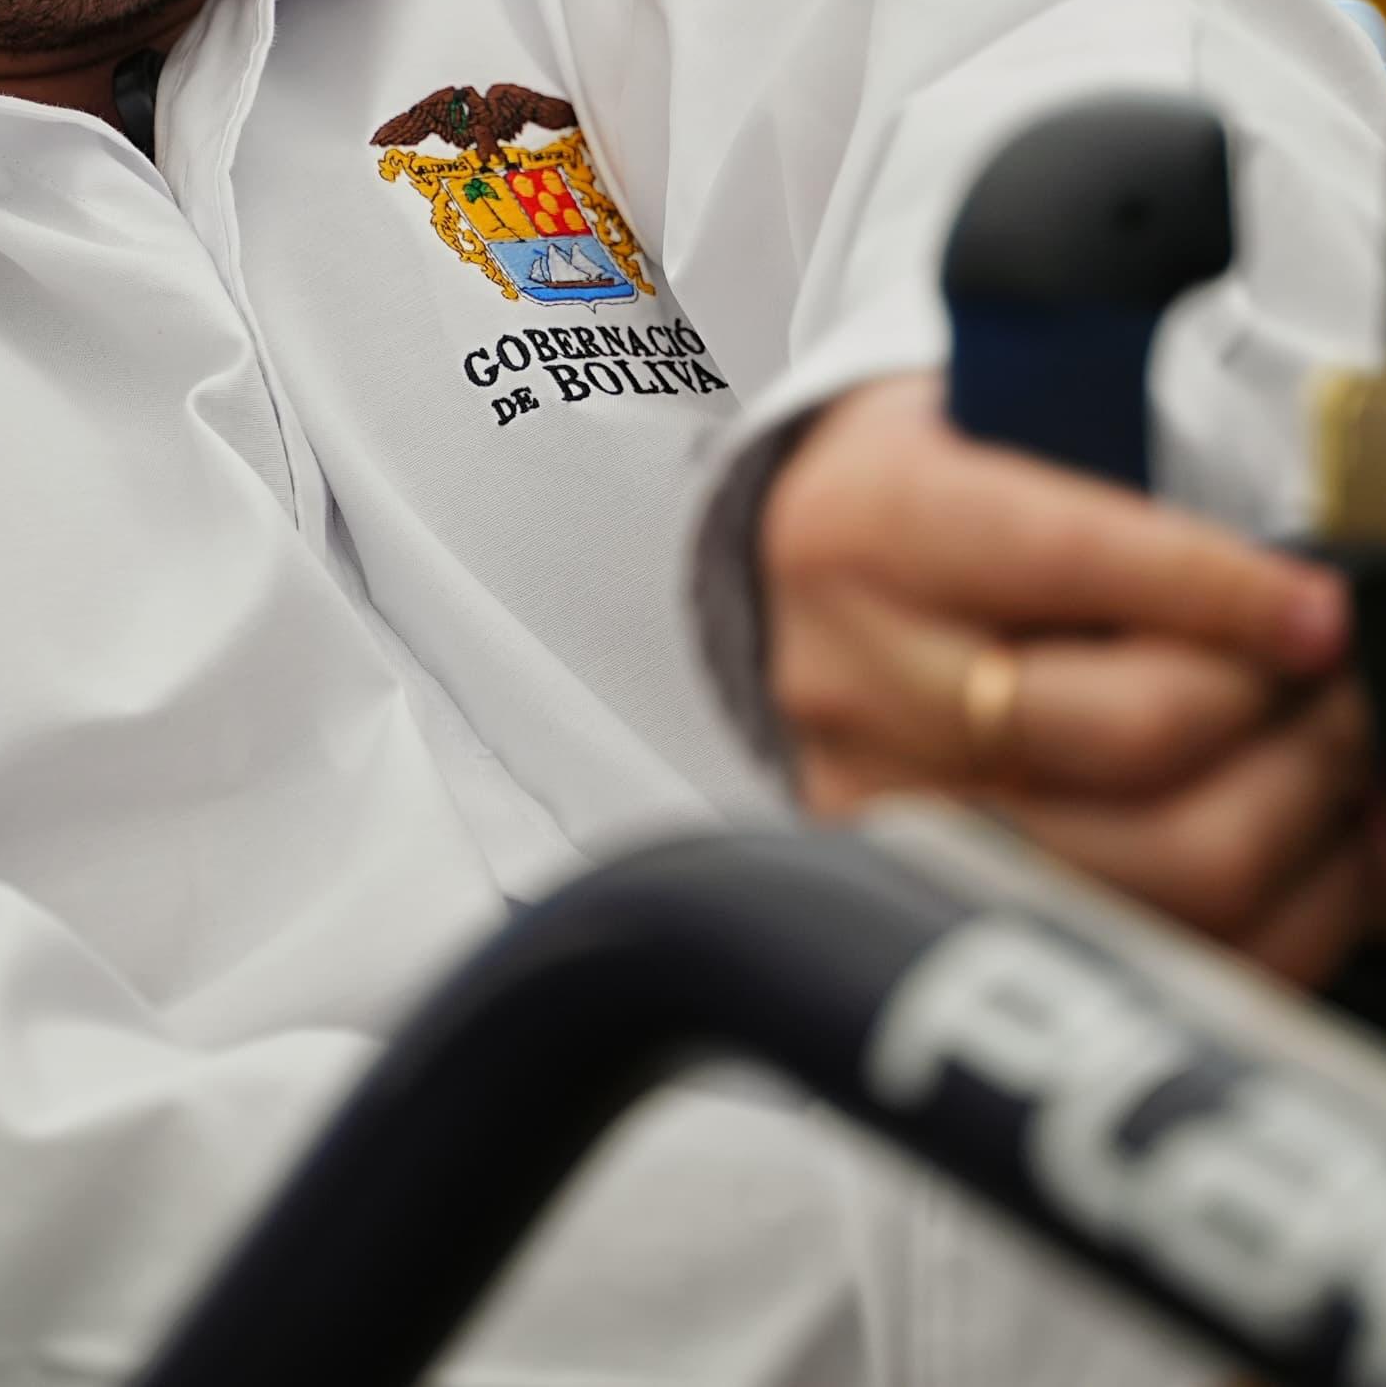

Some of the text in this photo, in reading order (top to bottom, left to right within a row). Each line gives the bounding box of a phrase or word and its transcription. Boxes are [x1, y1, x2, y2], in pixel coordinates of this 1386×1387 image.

[463, 318, 706, 387] GOBERNACIÓ
[491, 359, 729, 426] DE BOLIVA
